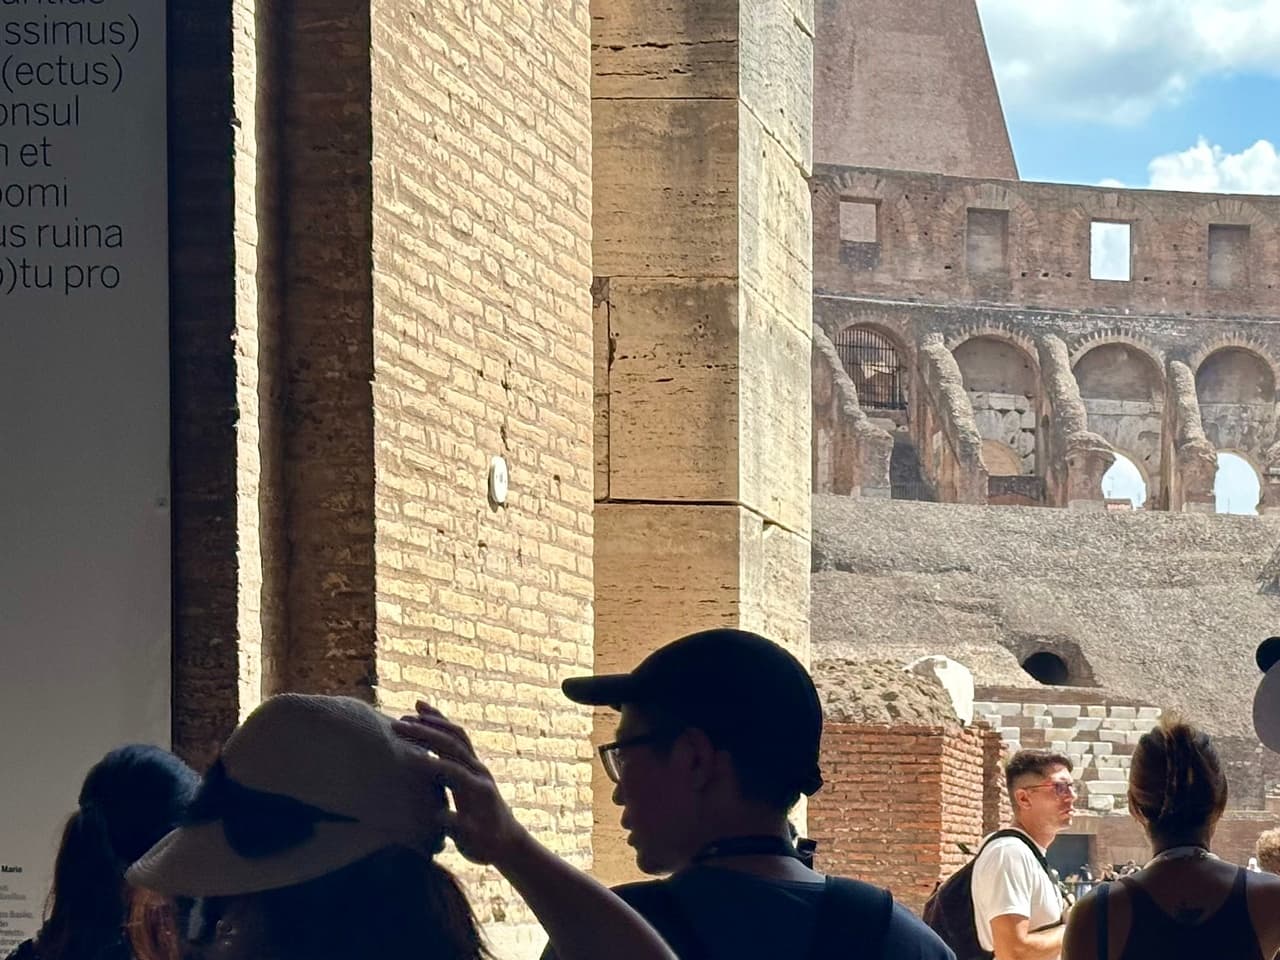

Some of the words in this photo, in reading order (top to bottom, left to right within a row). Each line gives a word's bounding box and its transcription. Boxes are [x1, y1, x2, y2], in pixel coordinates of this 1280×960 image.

[4, 13, 139, 53] ssimus)
[1, 53, 123, 94] (ectus)
[19, 136, 53, 168] et
[0, 177, 68, 208] omi
[37, 217, 123, 249] ruina
[0, 257, 53, 296] )tu
[64, 264, 120, 296] pro
